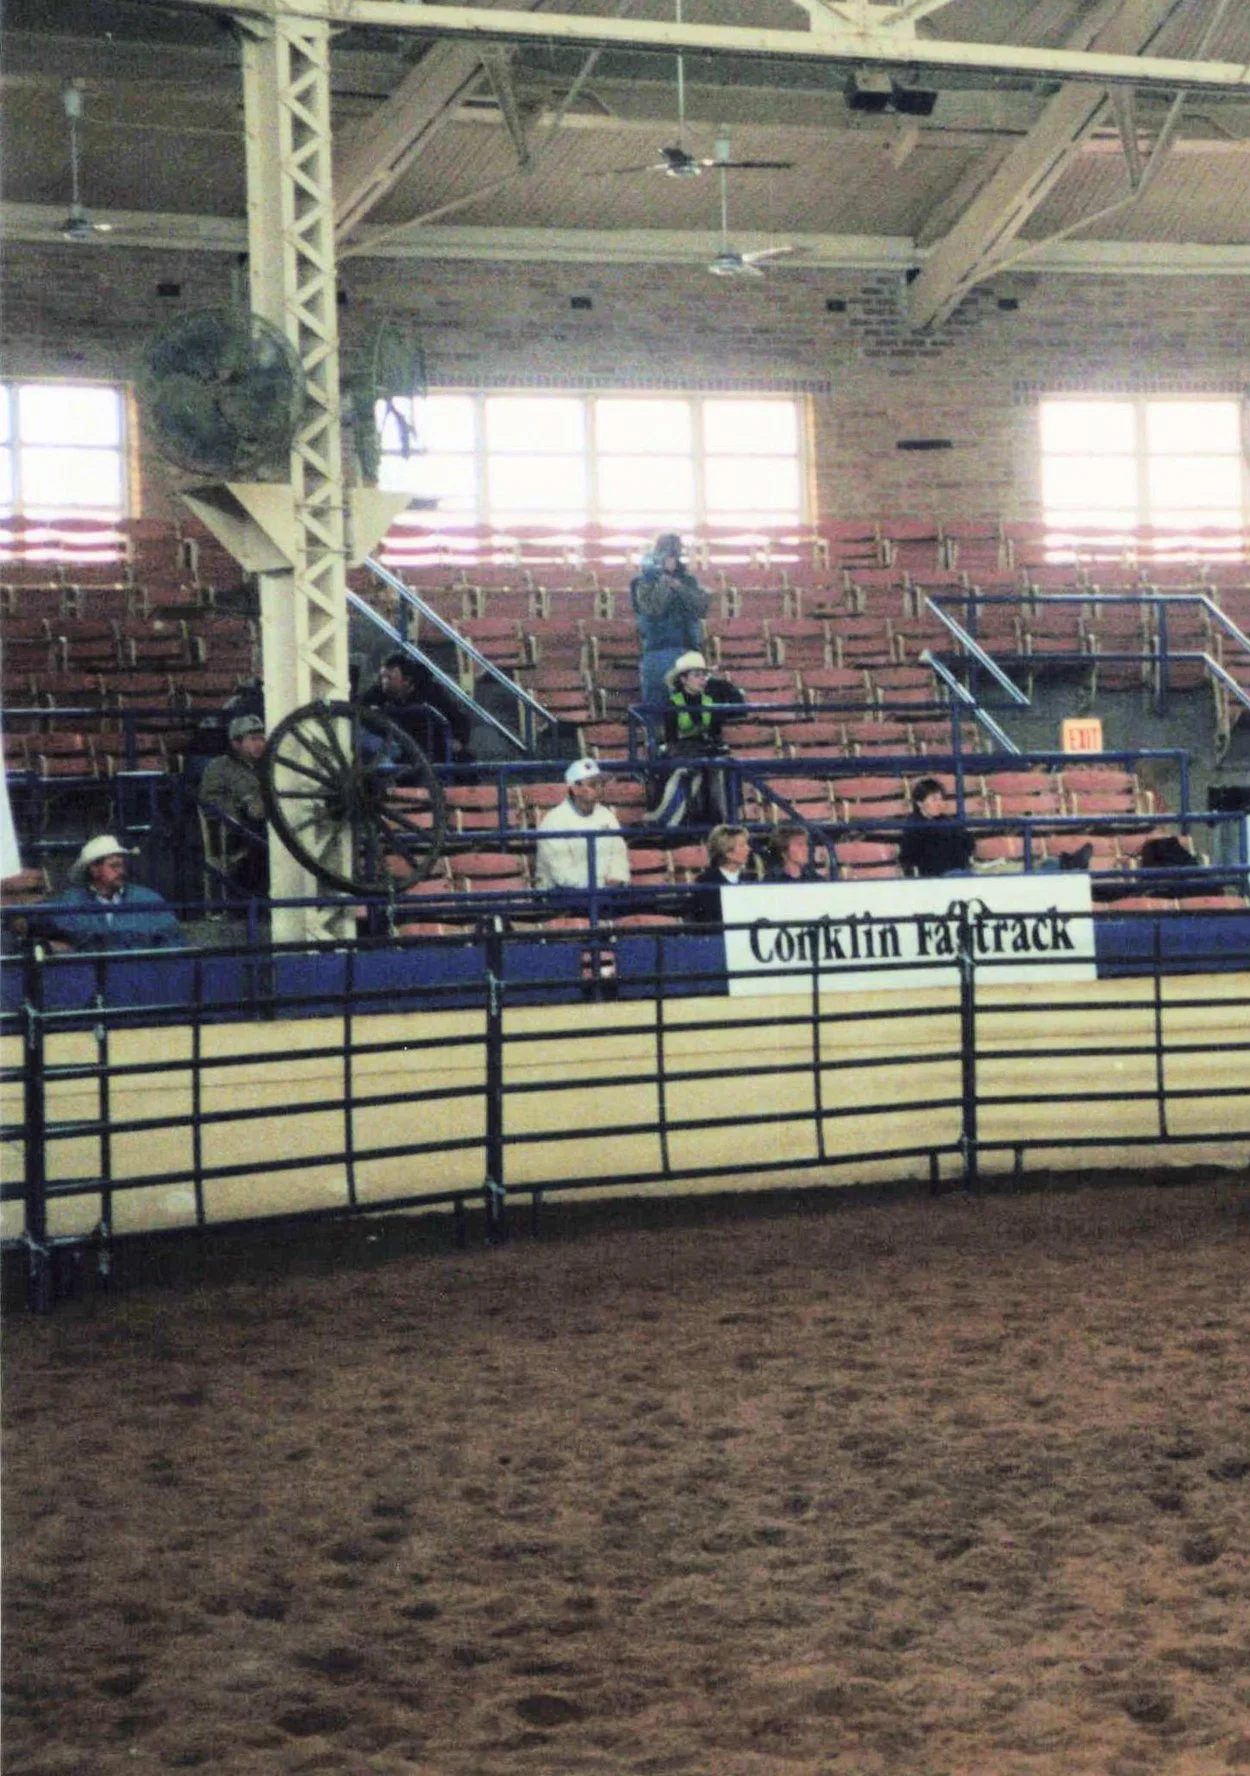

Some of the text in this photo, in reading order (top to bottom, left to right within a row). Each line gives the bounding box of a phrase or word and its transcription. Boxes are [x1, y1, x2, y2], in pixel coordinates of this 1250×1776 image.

[1068, 727, 1098, 750] EXIT
[749, 897, 1076, 964] Conklin Fatrack
